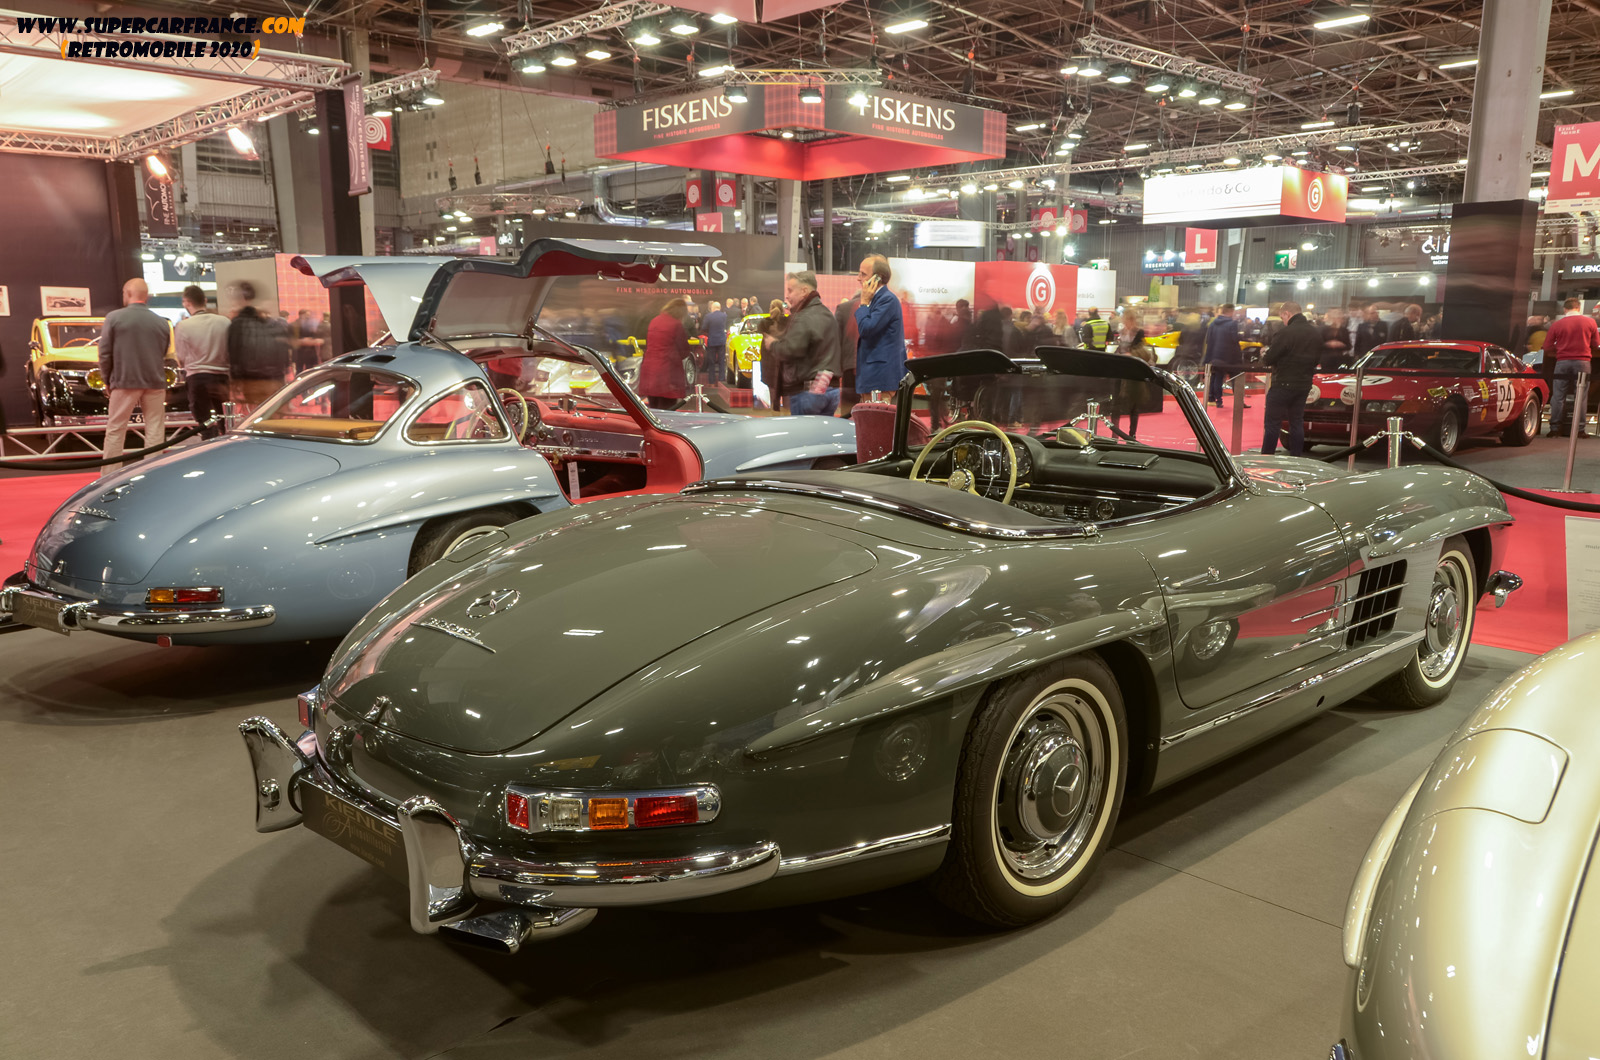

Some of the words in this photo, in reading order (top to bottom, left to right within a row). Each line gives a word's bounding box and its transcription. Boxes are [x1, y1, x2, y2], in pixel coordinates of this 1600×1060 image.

[642, 94, 733, 132] FISKENS
[857, 95, 956, 131] FISKENS
[1562, 143, 1600, 182] M
[1195, 233, 1208, 254] L
[616, 286, 633, 294] FINE
[635, 287, 668, 295] HISTORIC
[670, 288, 713, 296] AUTOMOBILES
[1499, 383, 1513, 413] 24
[325, 794, 398, 845] KIENLE
